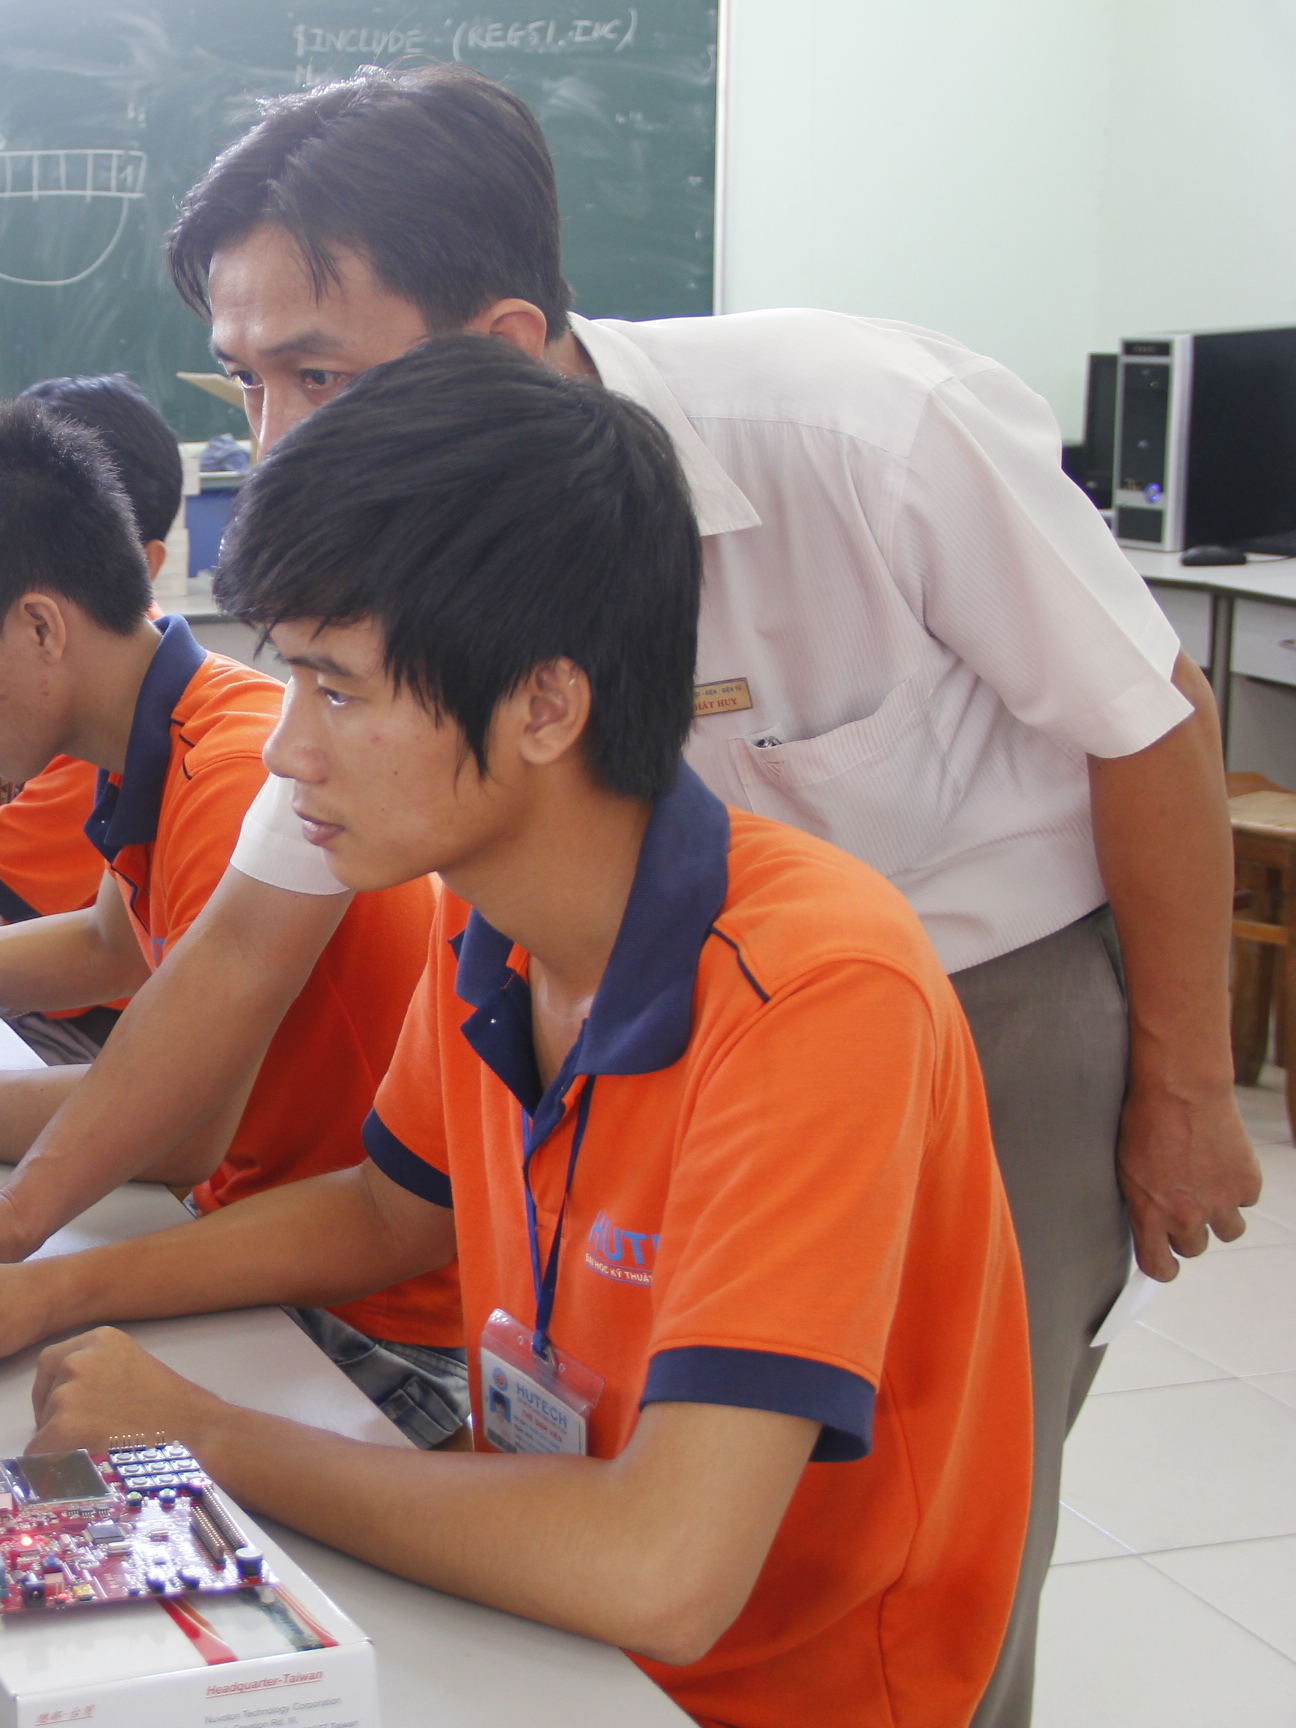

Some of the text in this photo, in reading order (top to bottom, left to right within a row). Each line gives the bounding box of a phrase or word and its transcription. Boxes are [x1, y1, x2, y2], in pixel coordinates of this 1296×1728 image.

[694, 698, 737, 711] HÁT HUY
[588, 1209, 661, 1266] HUT
[516, 1382, 568, 1429] HUTECH
[206, 1670, 323, 1697] Headquarter-Taiwan
[205, 1697, 341, 1724] Nuvoton Technology Corporation
